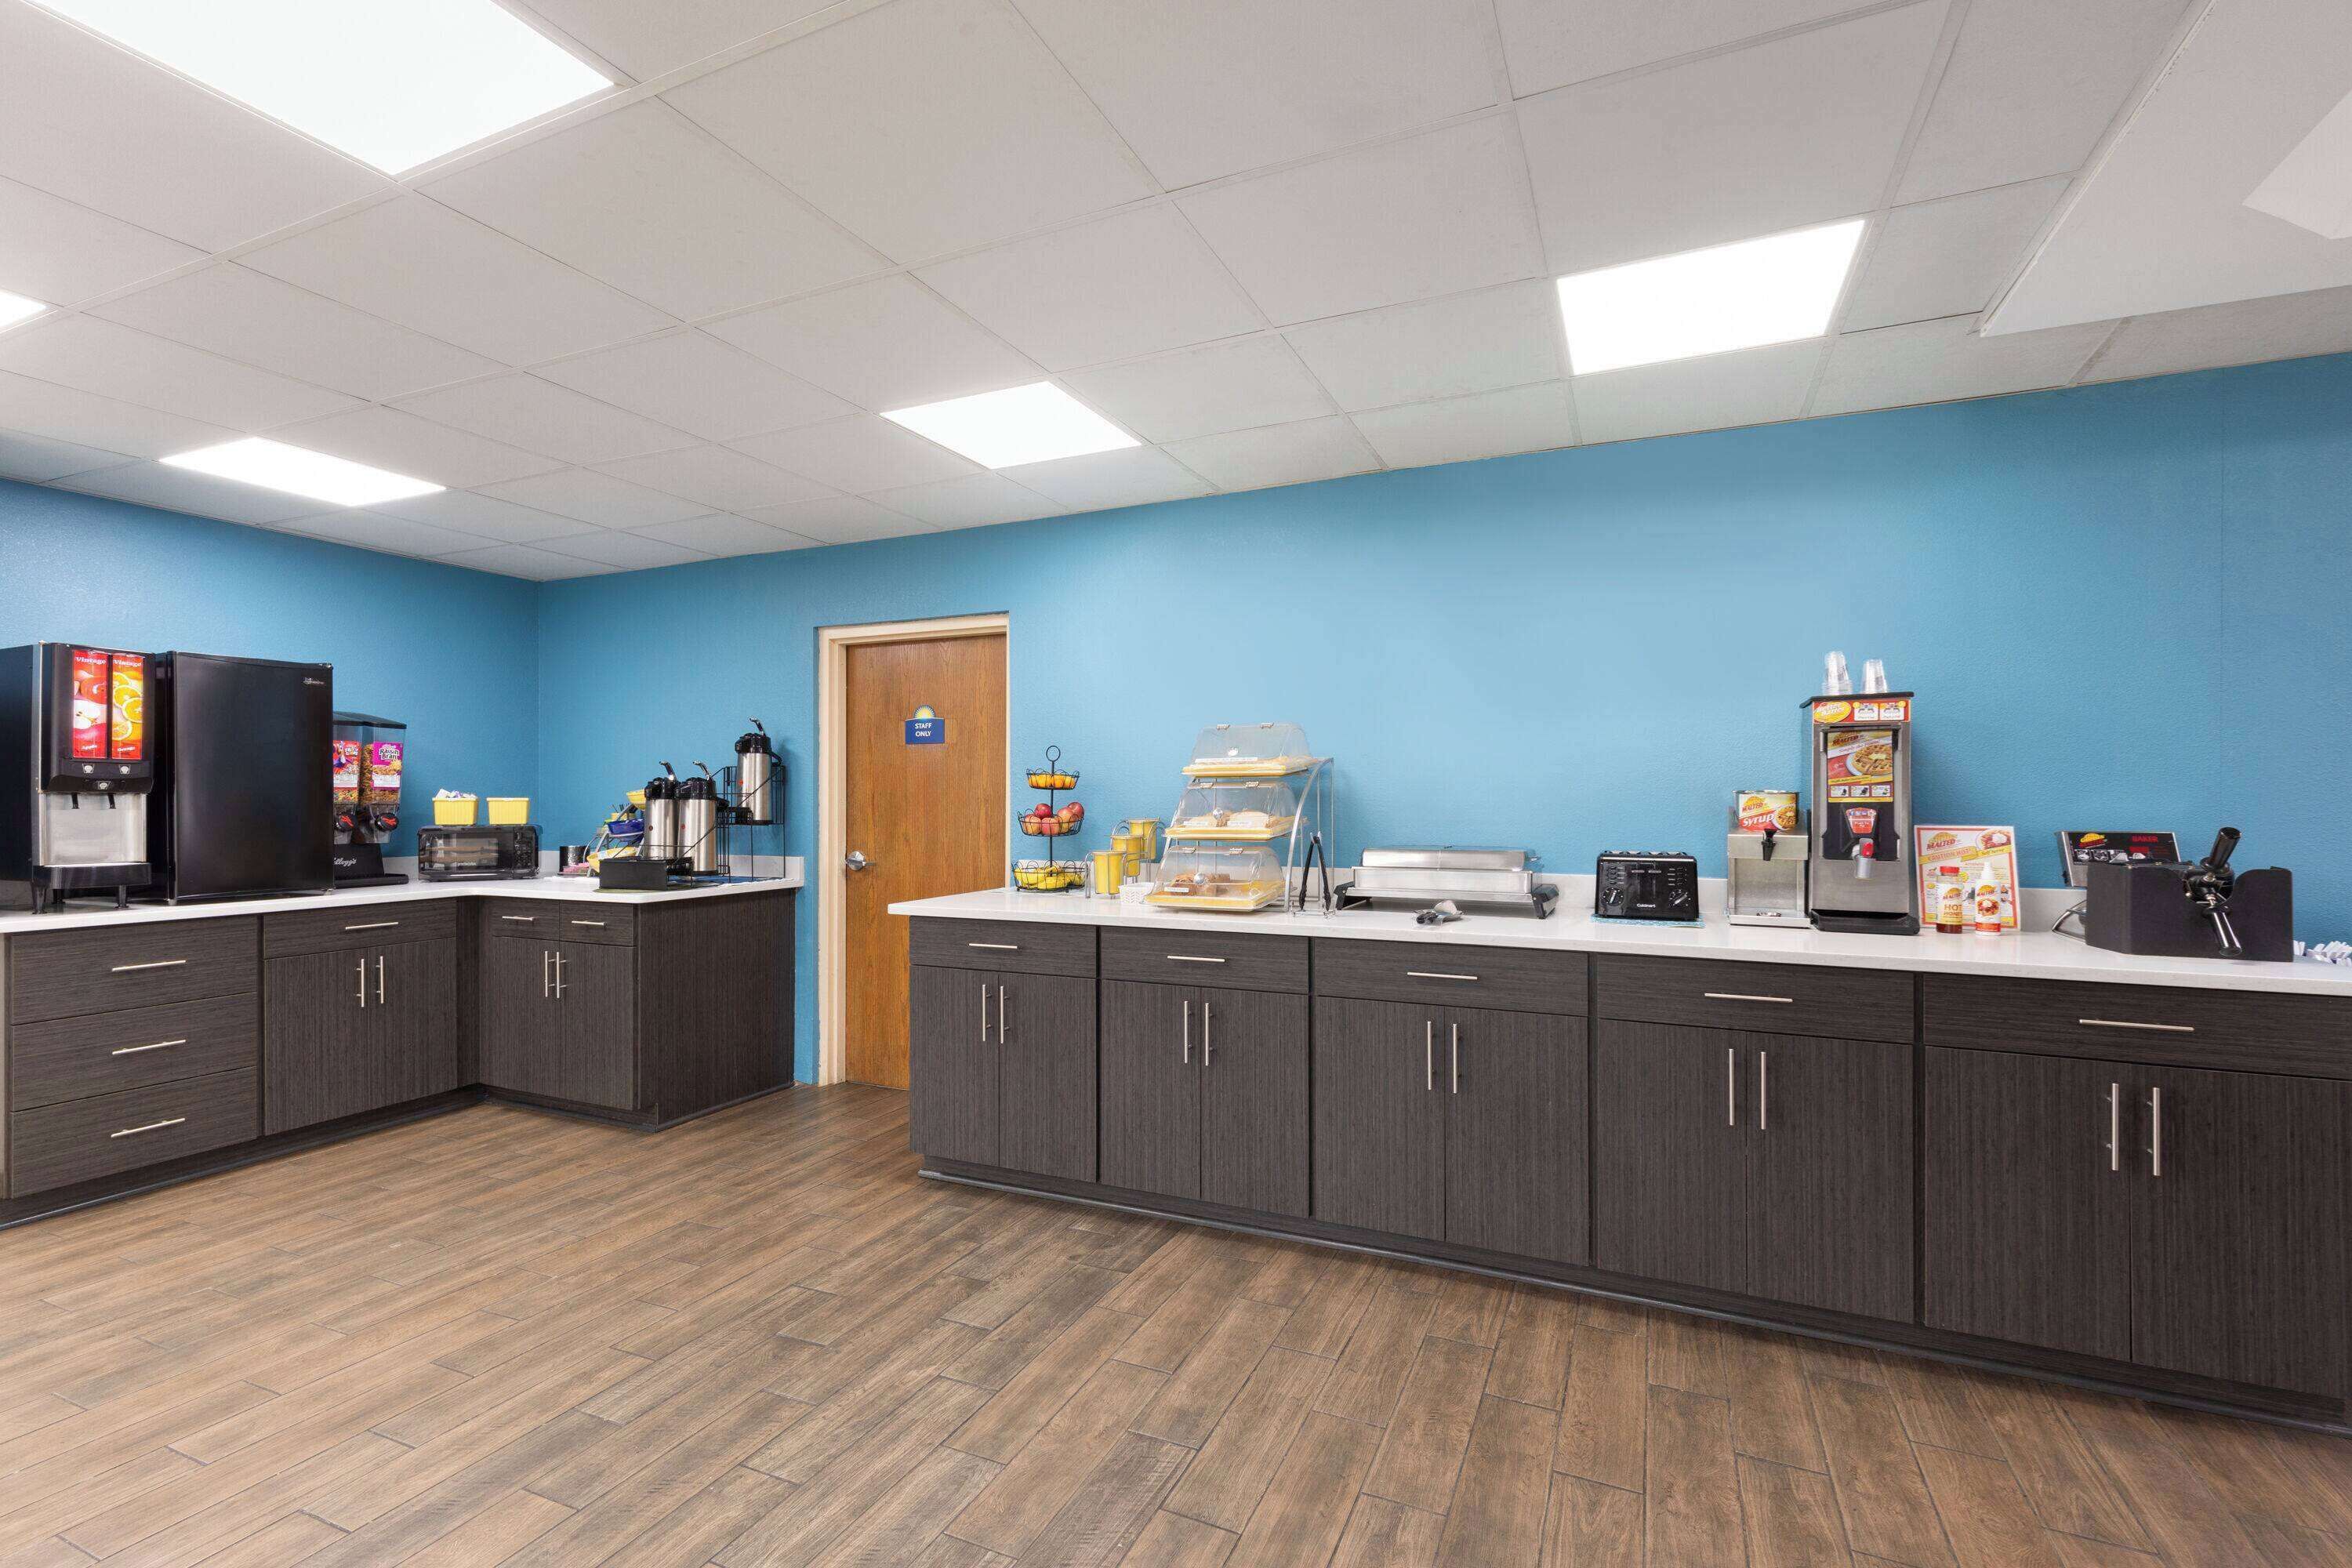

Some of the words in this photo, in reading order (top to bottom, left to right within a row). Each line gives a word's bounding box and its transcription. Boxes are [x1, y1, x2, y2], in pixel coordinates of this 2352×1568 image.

[1742, 813, 1774, 827] Syrup
[1926, 838, 1957, 851] MALTED
[334, 857, 357, 867] ellogg's
